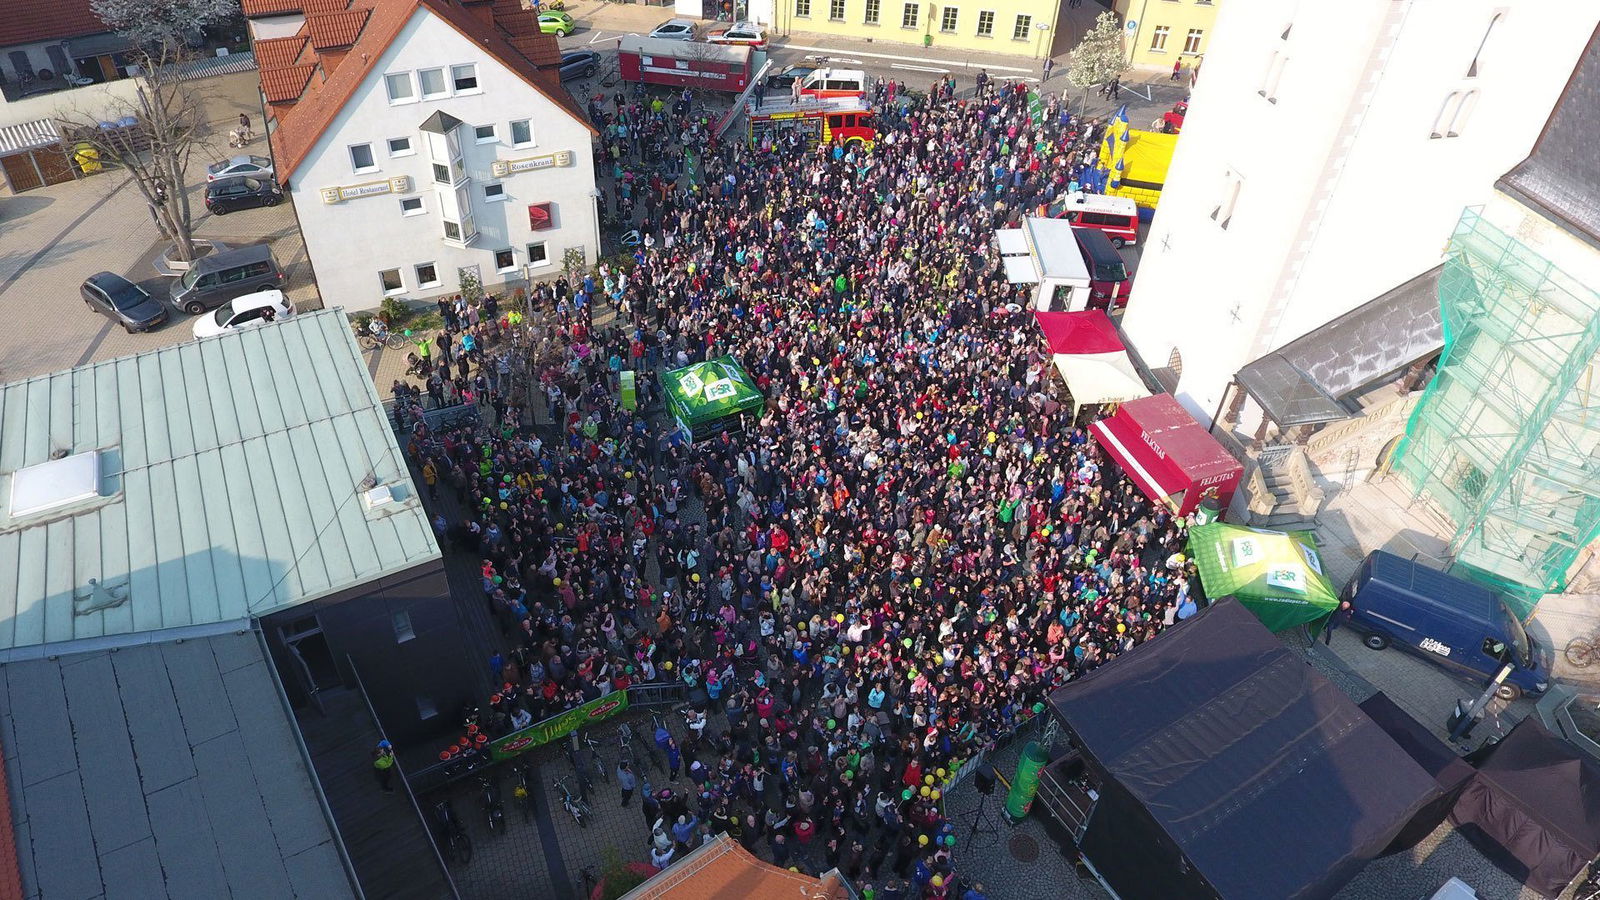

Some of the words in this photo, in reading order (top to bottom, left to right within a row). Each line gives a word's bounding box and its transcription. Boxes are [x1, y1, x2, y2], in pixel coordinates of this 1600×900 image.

[511, 159, 553, 171] Rosenkranz
[342, 188, 358, 198] Hotel
[359, 185, 389, 195] Restaurant
[1141, 430, 1166, 460] FELICITAS
[1200, 471, 1235, 486] FELICITAS
